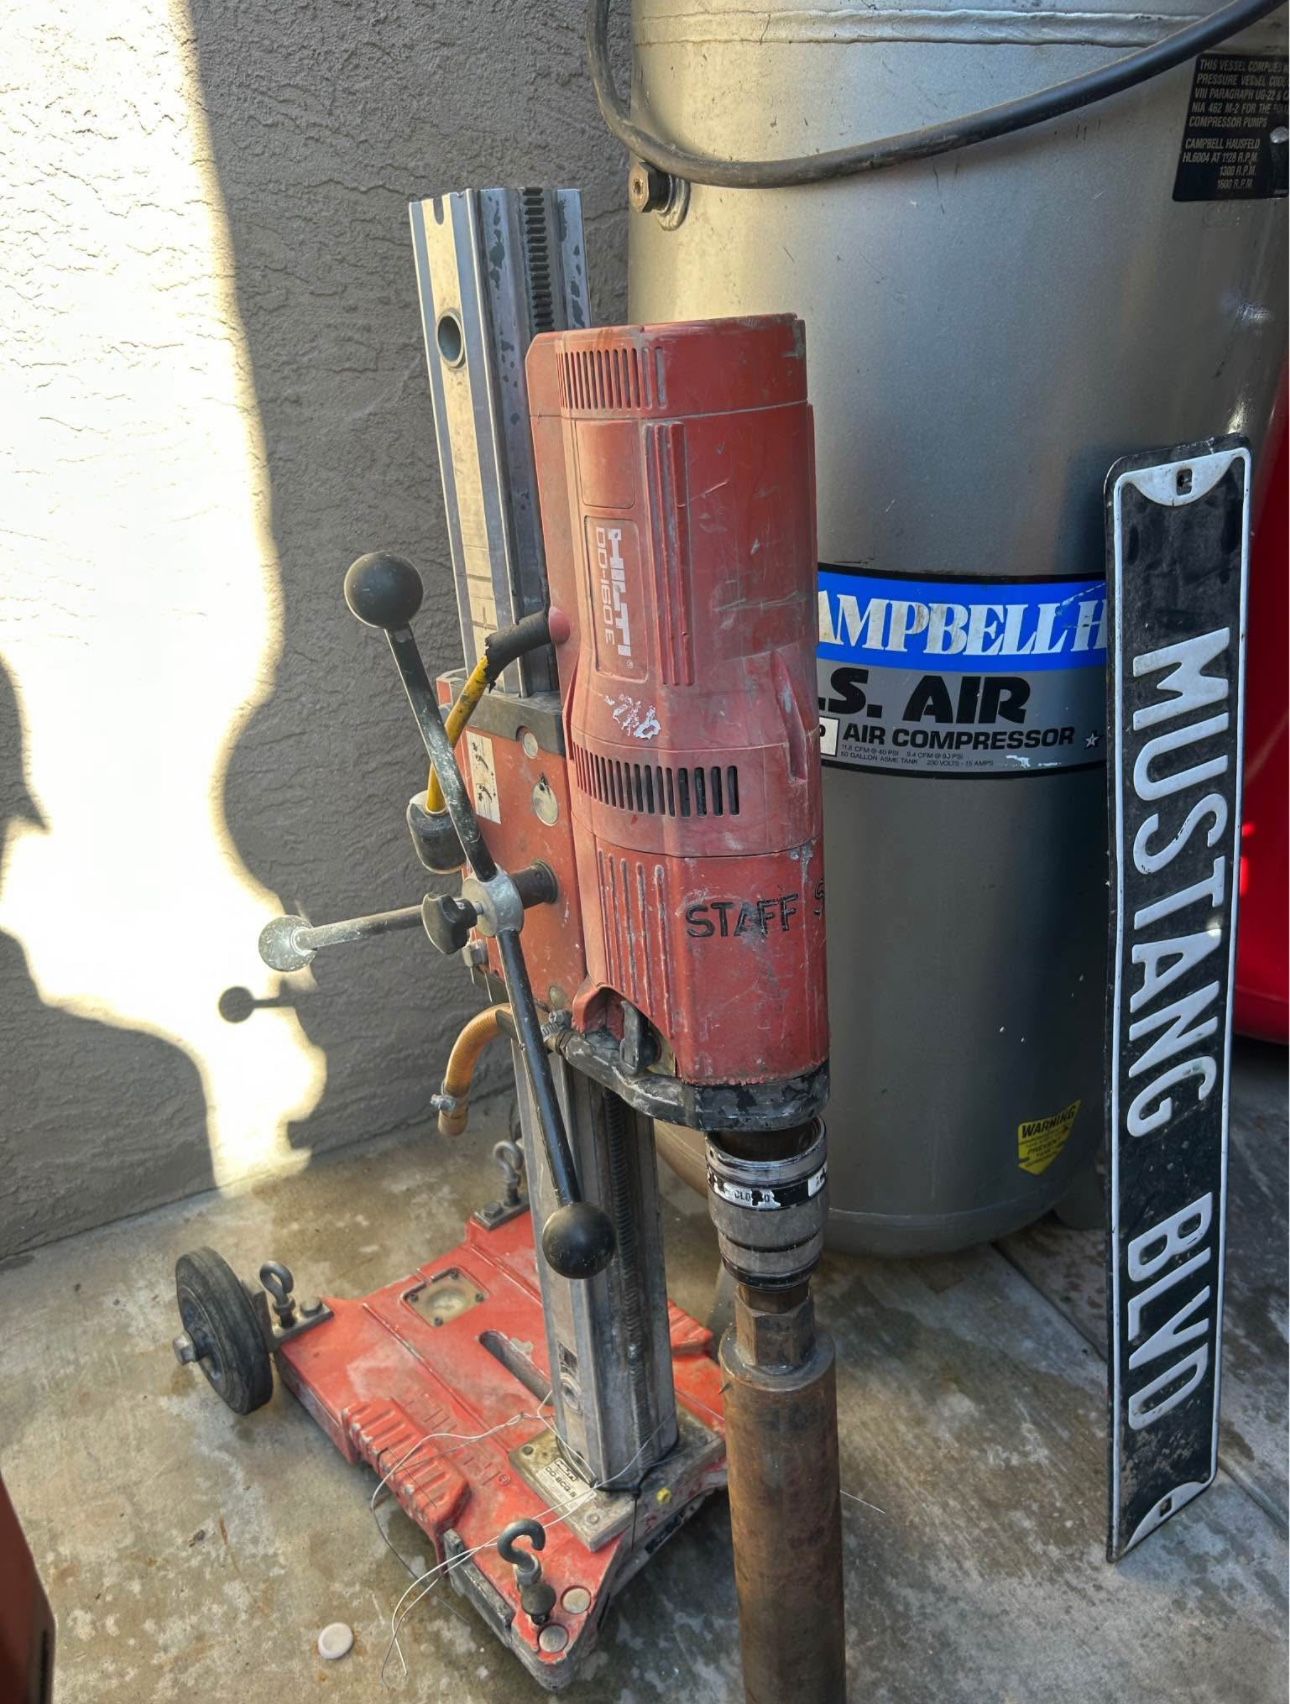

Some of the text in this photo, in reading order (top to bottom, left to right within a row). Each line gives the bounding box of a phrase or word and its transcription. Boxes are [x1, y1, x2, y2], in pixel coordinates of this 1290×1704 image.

[1200, 59, 1217, 70] THIS
[1220, 60, 1246, 71] VESSEL
[1197, 73, 1238, 85] PRESSURE
[1241, 74, 1265, 86] VESSEL
[1209, 88, 1254, 99] PARAGRAPH
[1241, 103, 1256, 113] FOR
[1259, 104, 1271, 113] THE
[1189, 116, 1267, 127] COMPRESSOR PUMPS
[1185, 138, 1260, 149] CAMPBELL HAUSFELD
[1211, 152, 1220, 163] AT
[596, 527, 616, 646] DD-160 E
[607, 529, 632, 657] HILTI
[903, 676, 1030, 724] AIR
[843, 723, 886, 744] AIR
[892, 726, 1074, 750] COMPRESSOR
[685, 893, 798, 938] STAFF
[1127, 627, 1230, 1431] MUSTANG BLVD
[1022, 1103, 1076, 1139] WARNING
